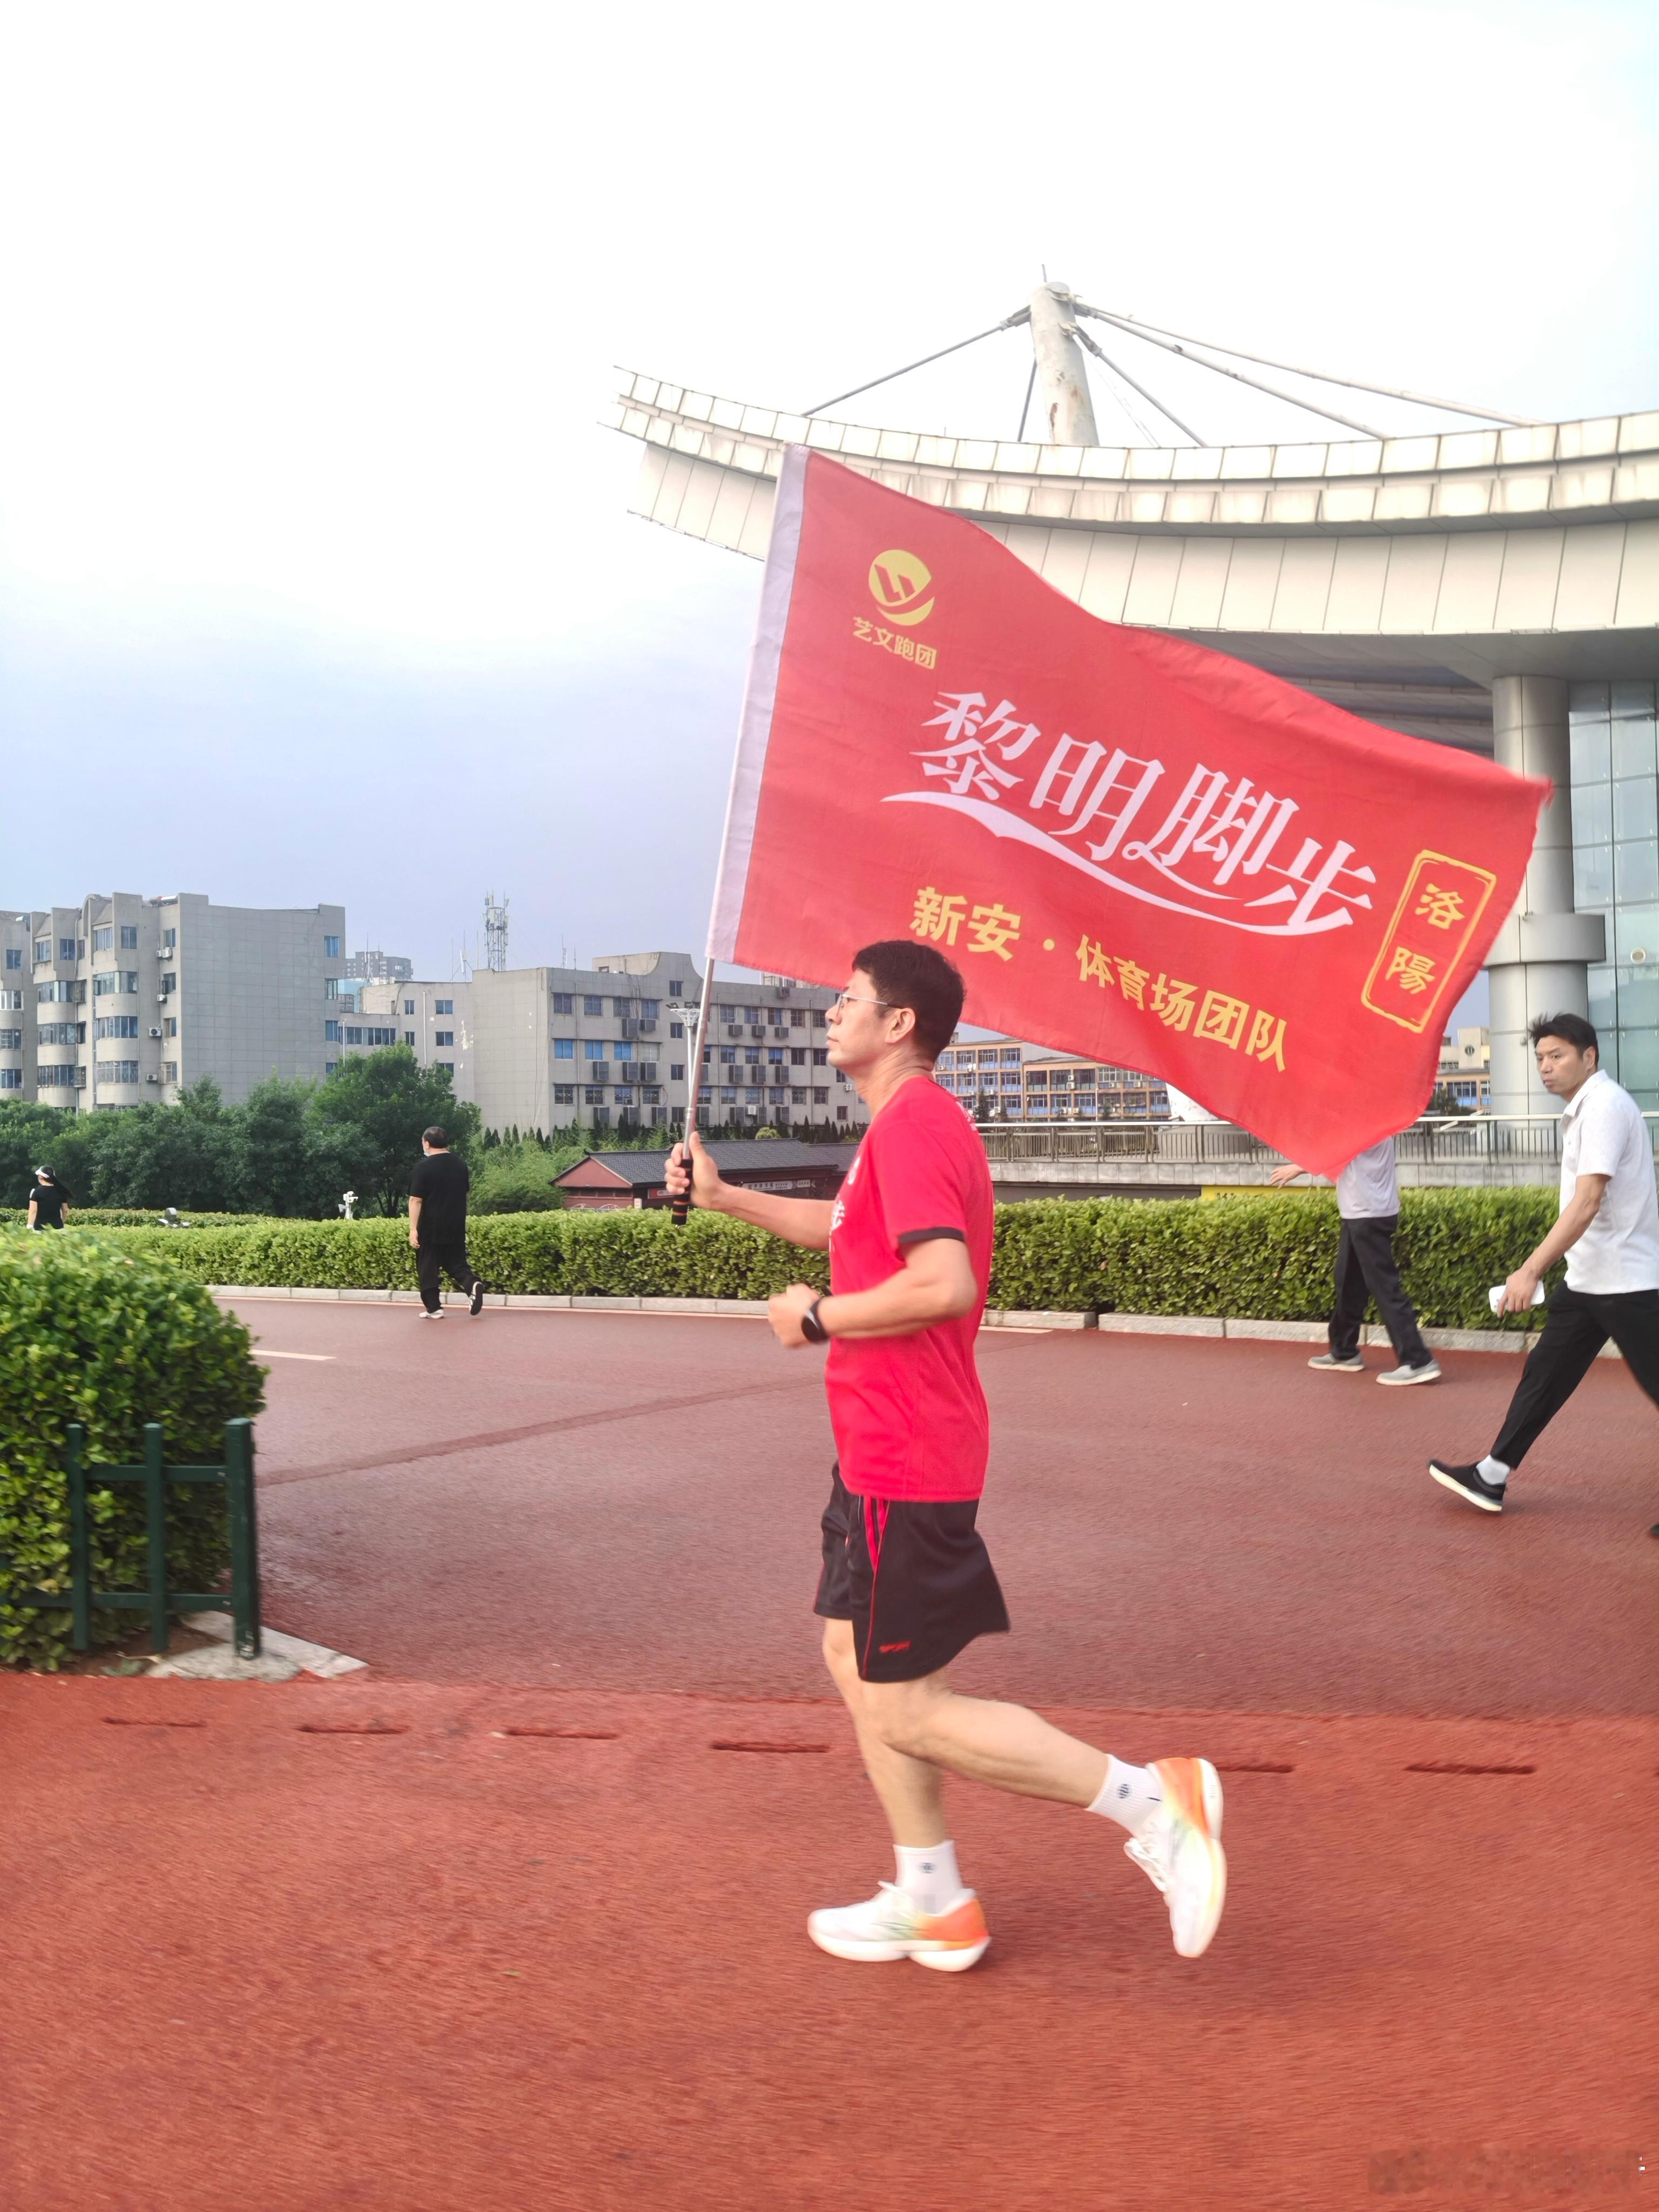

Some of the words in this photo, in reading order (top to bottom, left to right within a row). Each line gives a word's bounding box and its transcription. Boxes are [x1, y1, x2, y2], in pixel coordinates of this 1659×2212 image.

[852, 616, 938, 670] 艺文跑团
[909, 691, 1377, 935] 黎明脚步
[1385, 882, 1466, 995] 洛陽
